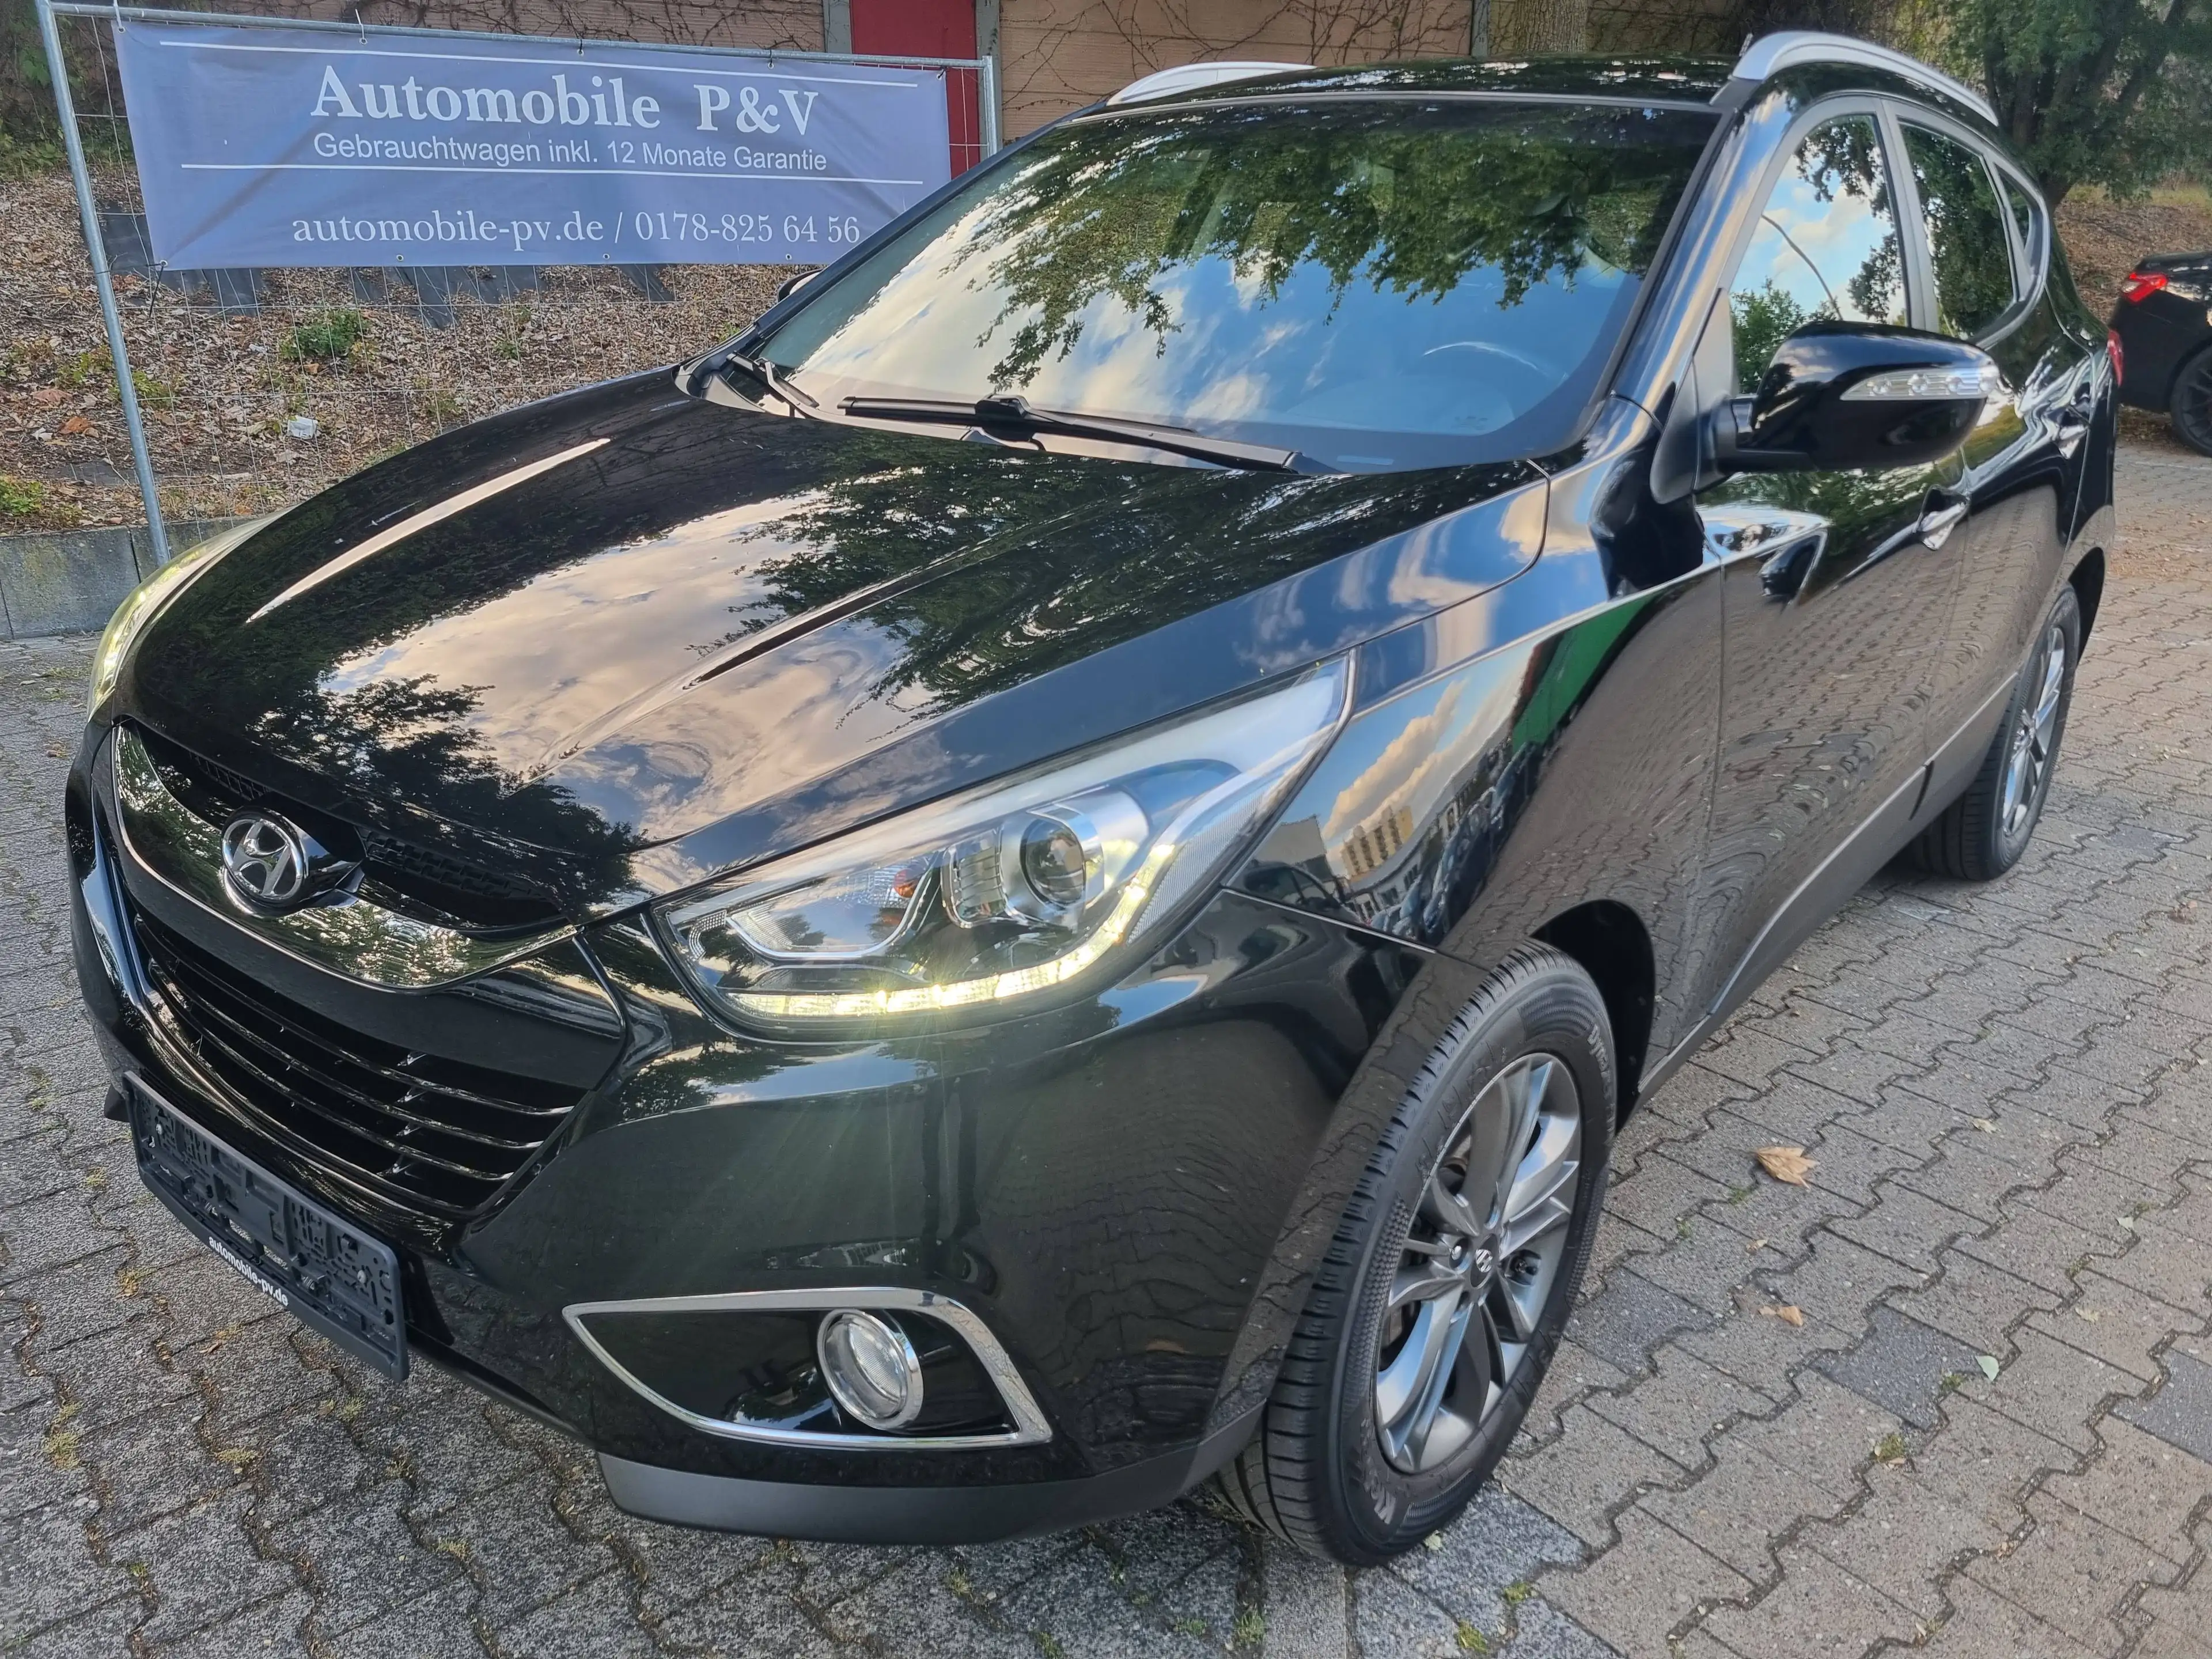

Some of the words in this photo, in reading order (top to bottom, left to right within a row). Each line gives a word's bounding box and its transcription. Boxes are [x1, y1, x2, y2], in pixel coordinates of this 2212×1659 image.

[310, 65, 660, 128] Automobile
[693, 84, 819, 135] P&V
[313, 132, 541, 167] Gebrauchtwagen
[548, 139, 599, 163] inkl.
[607, 141, 635, 164] 12
[642, 142, 726, 168] Monate
[734, 146, 827, 171] Garantie
[292, 210, 604, 252] automobile-pv.de
[614, 211, 623, 244] /
[635, 210, 772, 243] 0178-825
[783, 215, 818, 243] 64
[828, 216, 860, 244] 56
[209, 1236, 289, 1306] automobile-pv.de
